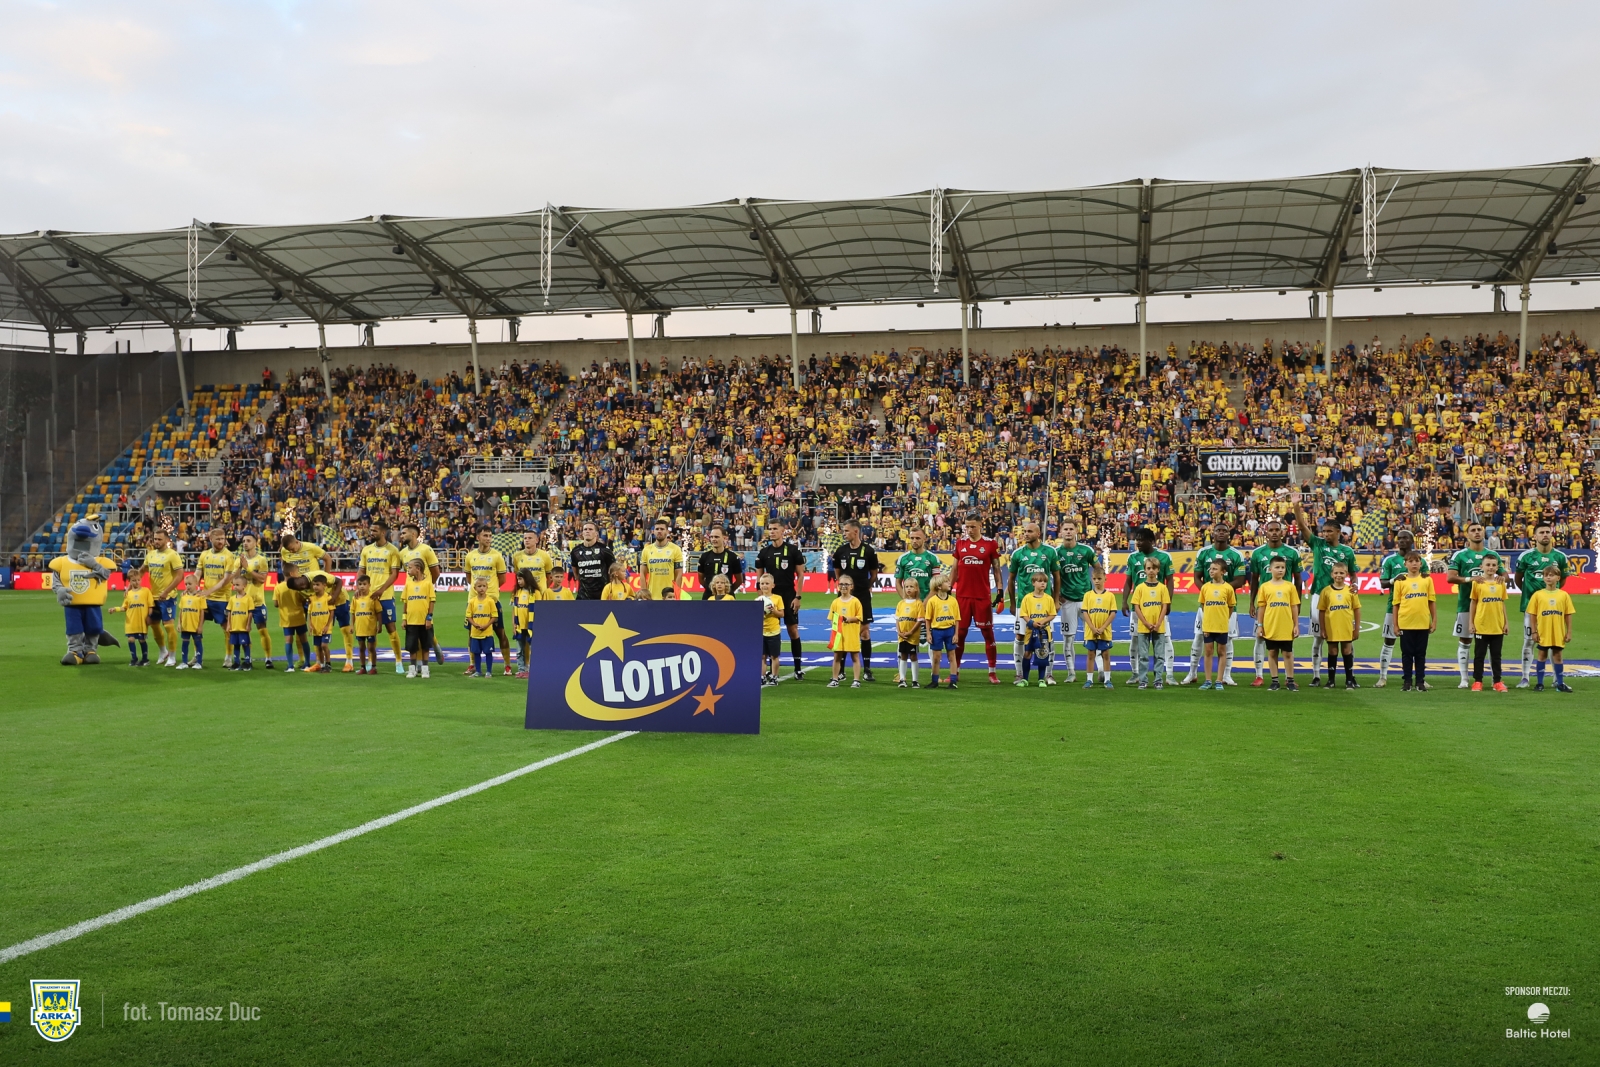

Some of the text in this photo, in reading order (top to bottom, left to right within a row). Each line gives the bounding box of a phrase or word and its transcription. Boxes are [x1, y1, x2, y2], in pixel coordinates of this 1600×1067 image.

[1206, 454, 1283, 471] GNIEWINO
[824, 470, 832, 479] G
[884, 470, 896, 478] 15
[438, 577, 468, 586] ARKA
[1456, 624, 1462, 633] 6
[600, 651, 701, 702] LOTTO
